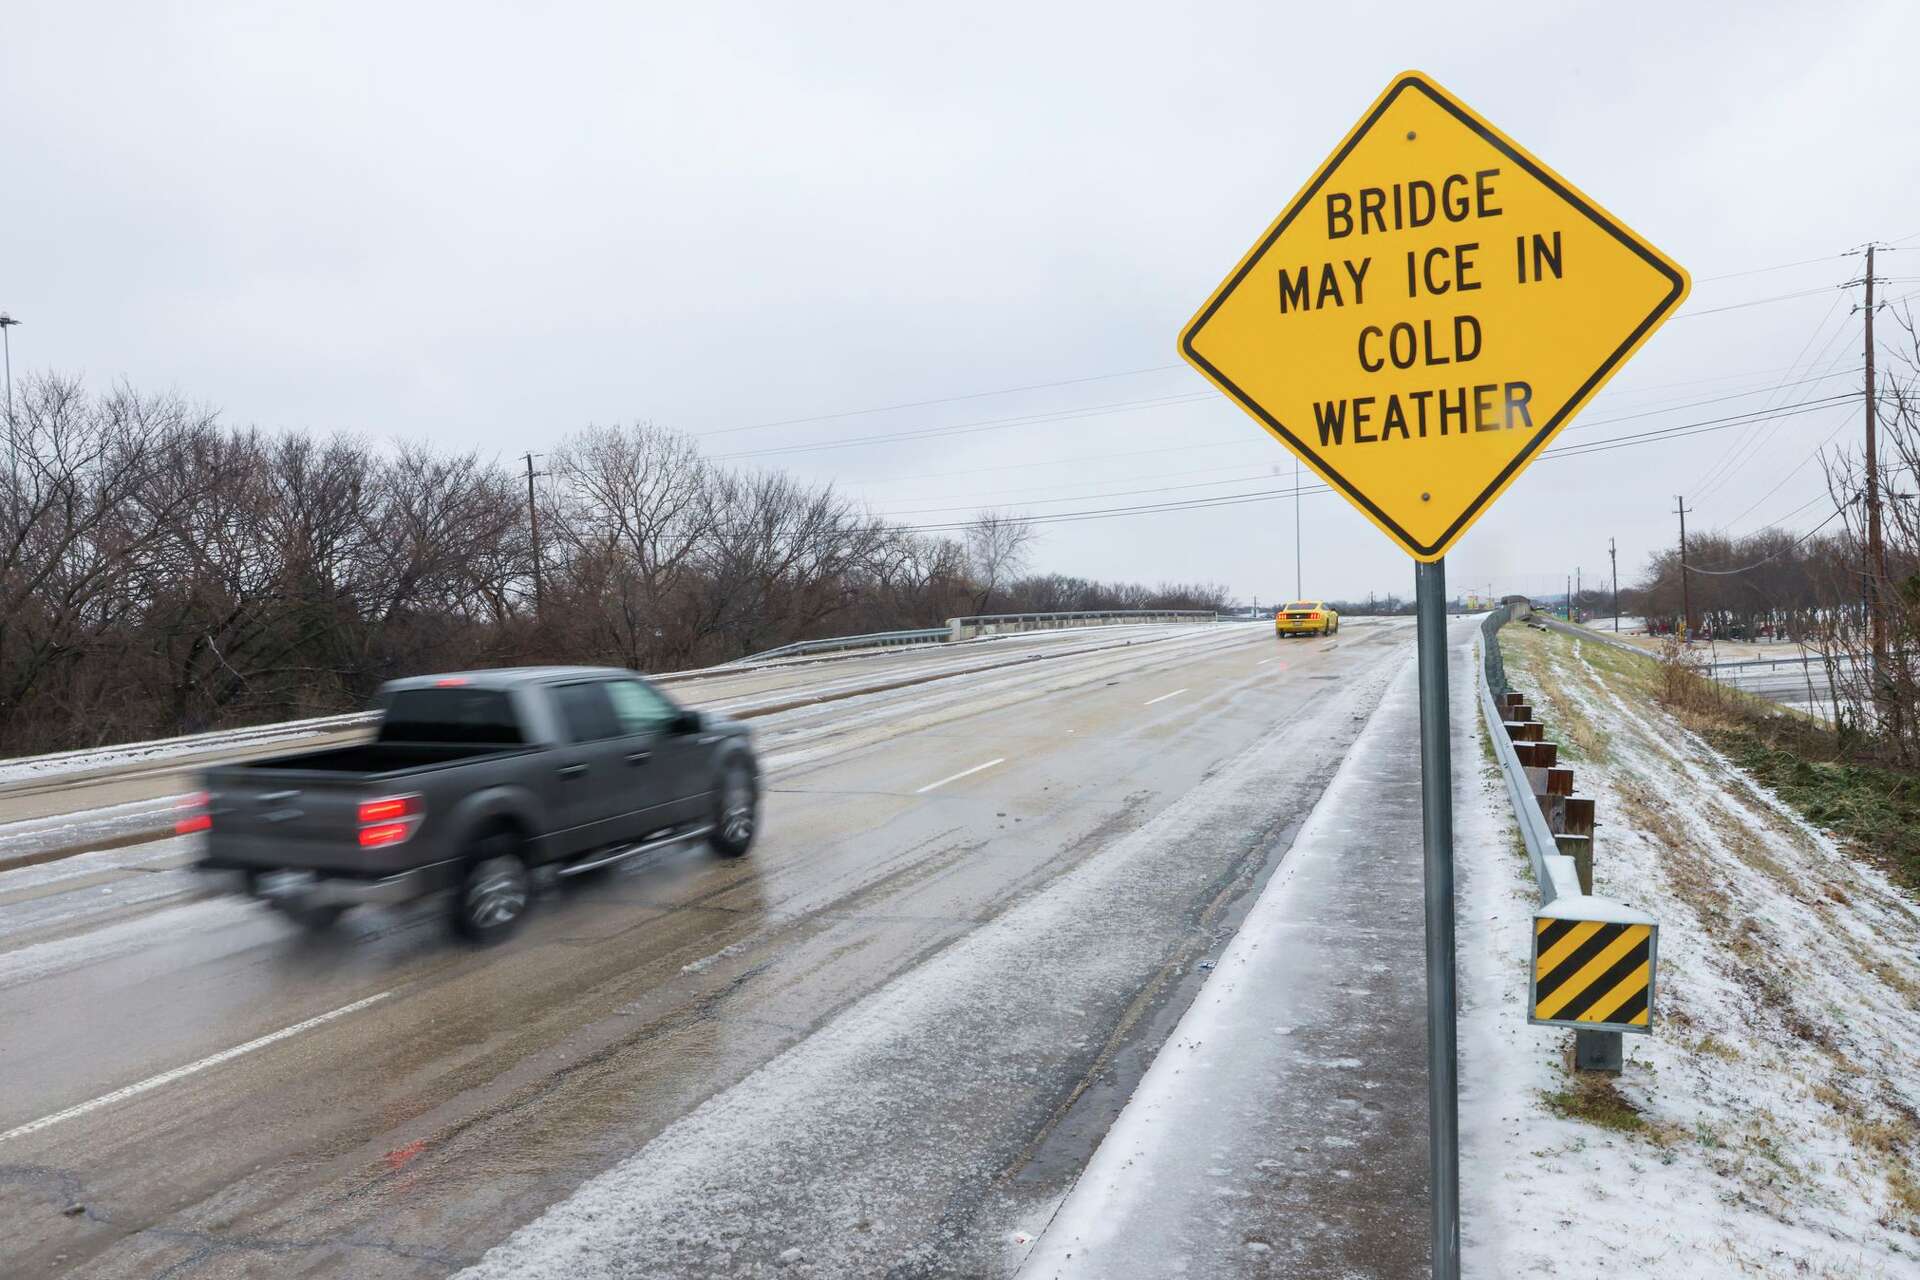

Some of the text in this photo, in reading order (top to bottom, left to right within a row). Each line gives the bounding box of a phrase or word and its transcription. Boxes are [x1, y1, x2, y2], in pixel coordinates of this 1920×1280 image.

[1326, 168, 1503, 240] BRIDGE
[1278, 231, 1563, 314] MAY ICE IN
[1358, 315, 1482, 373] COLD
[1313, 380, 1534, 447] WEATHER
